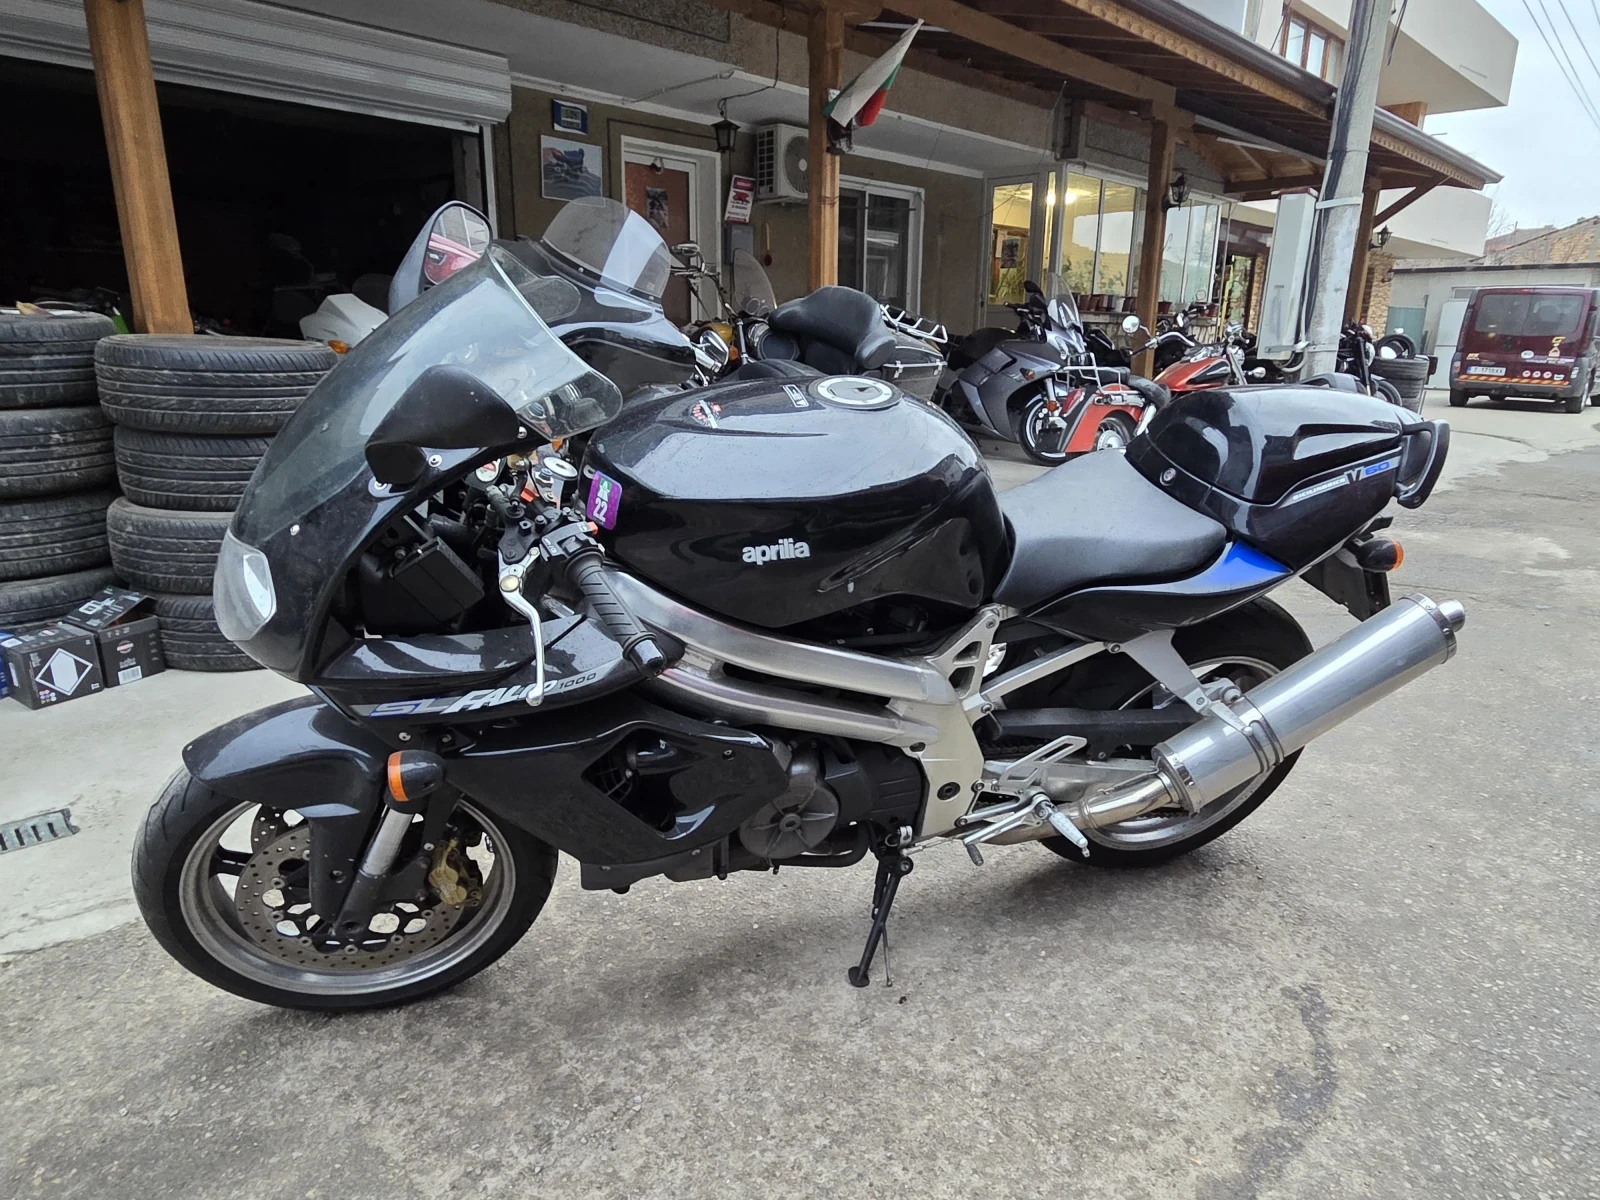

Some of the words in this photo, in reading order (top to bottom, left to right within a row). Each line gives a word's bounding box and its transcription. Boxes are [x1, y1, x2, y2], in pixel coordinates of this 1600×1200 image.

[593, 497, 608, 522] 22
[742, 537, 811, 566] aprilia
[369, 697, 452, 717] SL
[559, 672, 597, 690] 1000
